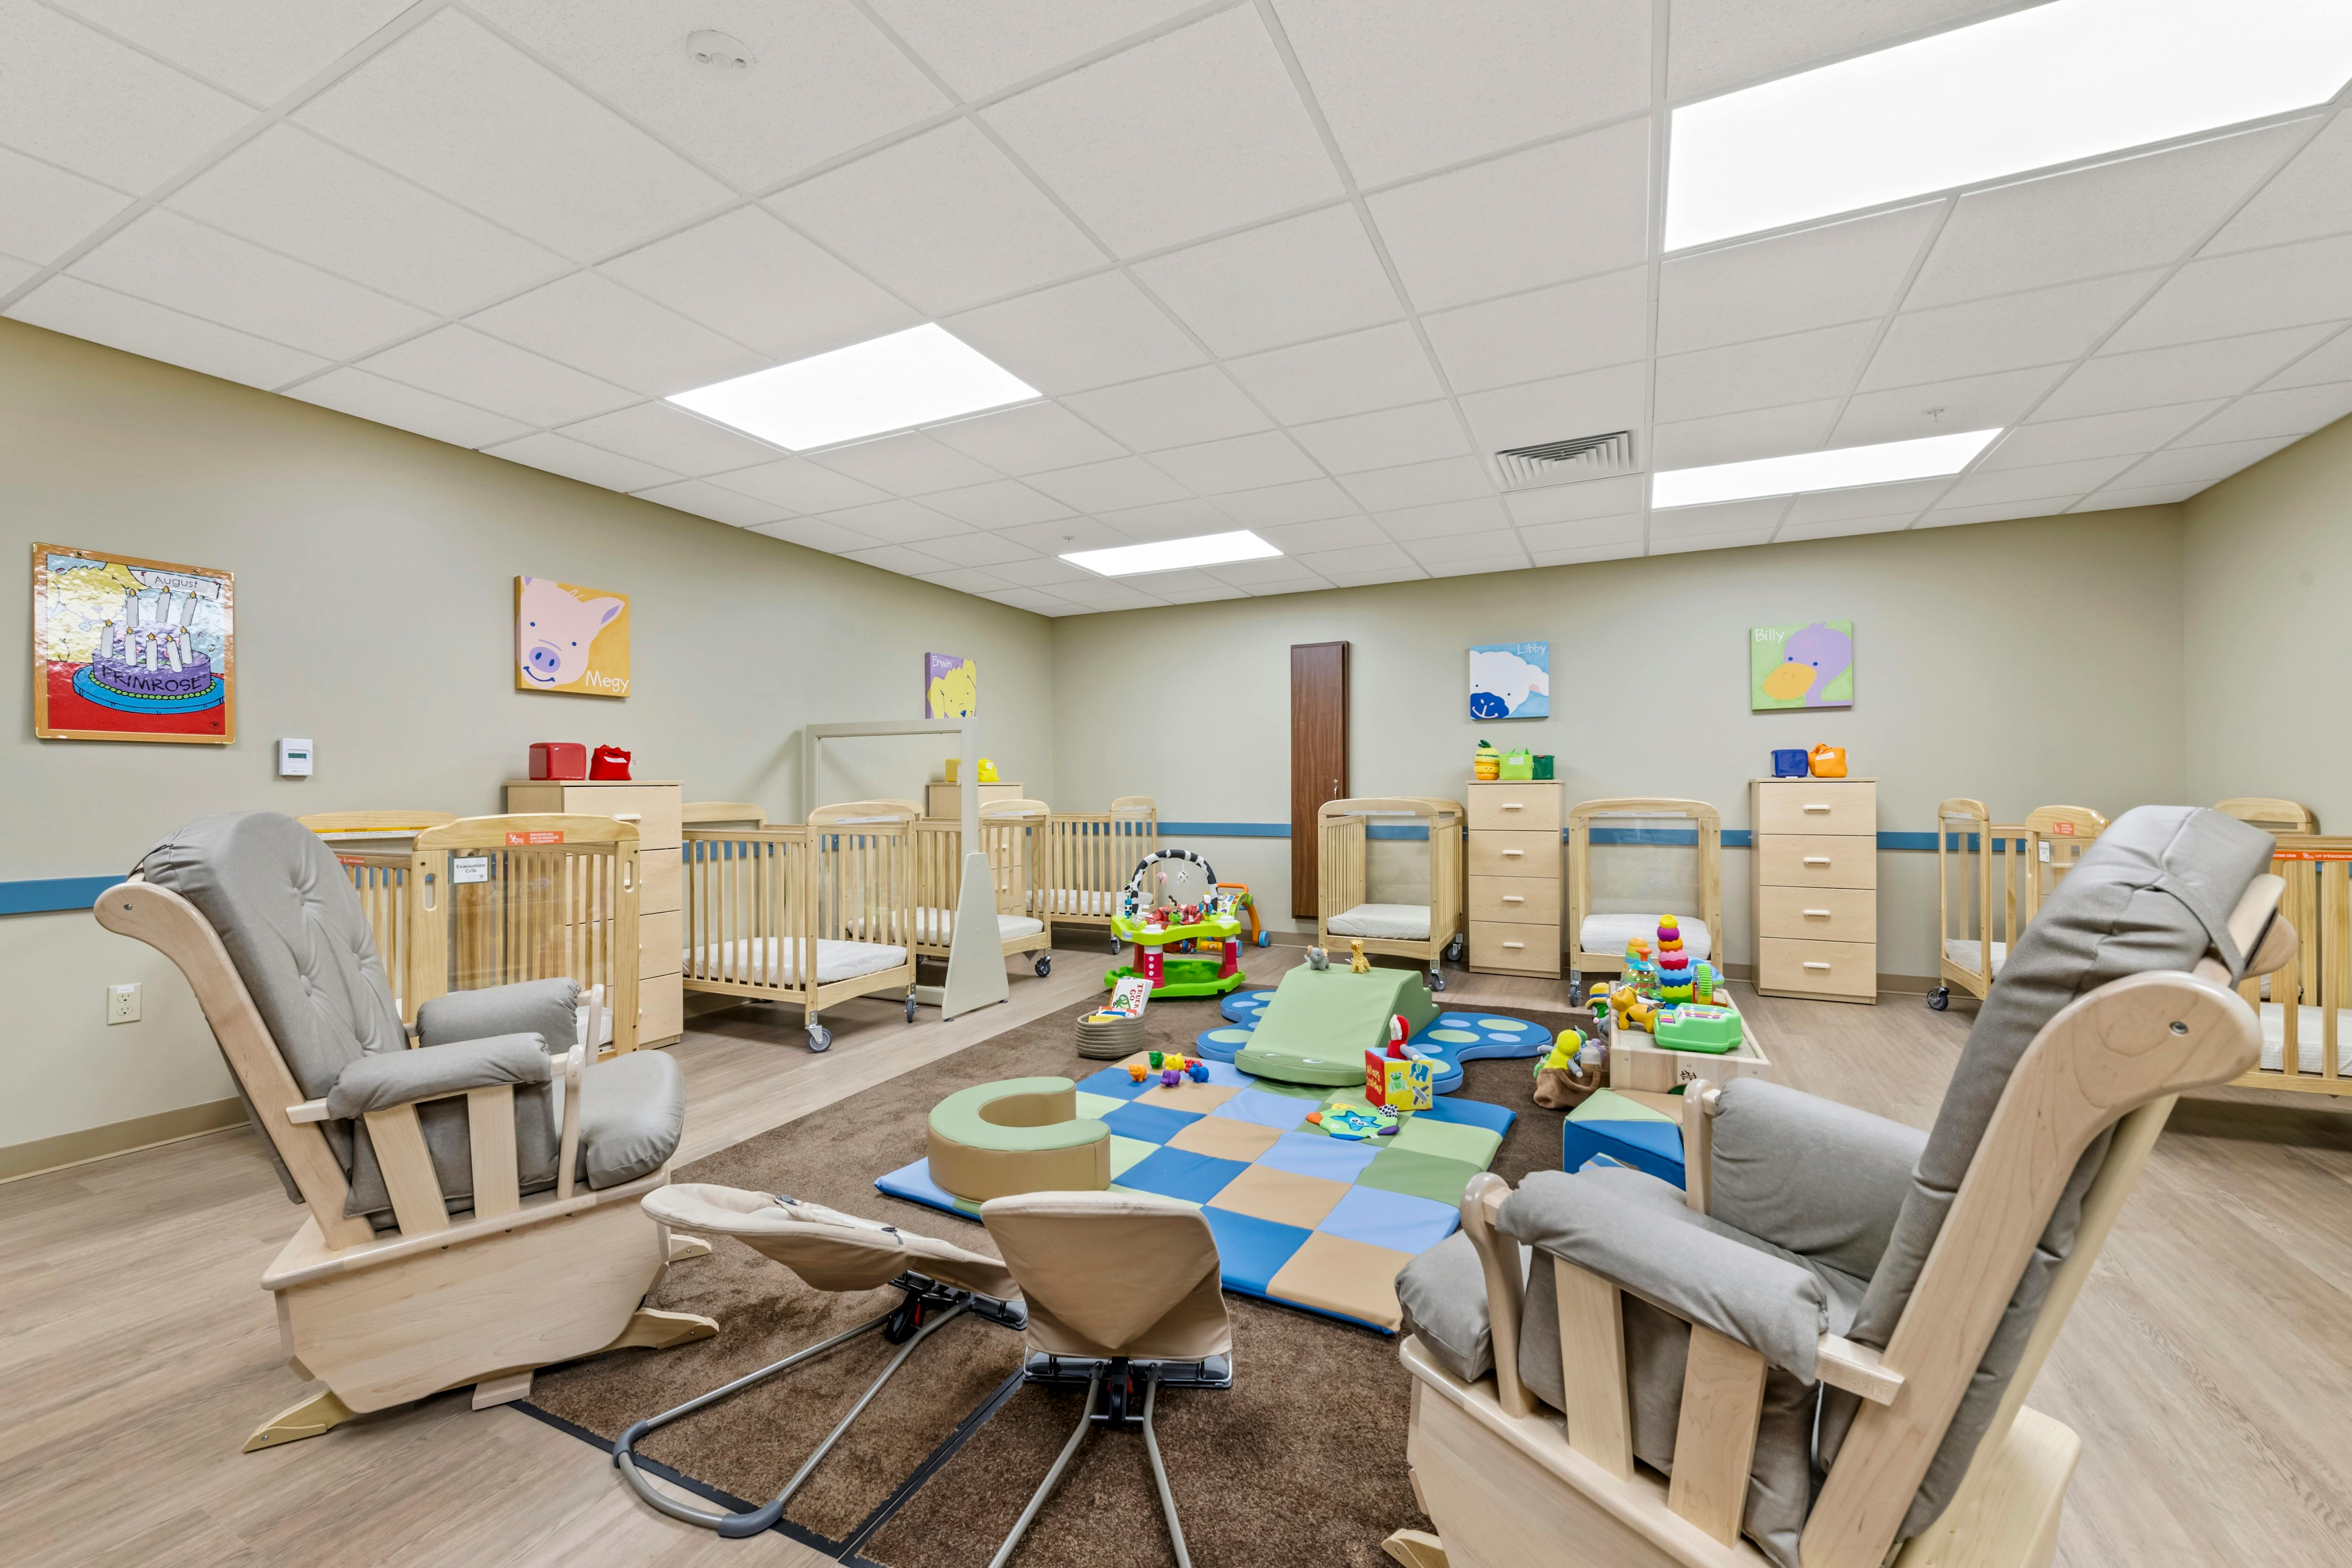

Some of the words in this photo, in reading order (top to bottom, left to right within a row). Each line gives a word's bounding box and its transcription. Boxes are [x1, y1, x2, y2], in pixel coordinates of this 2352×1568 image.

[155, 576, 198, 588] August
[1755, 628, 1785, 644] Billy
[1517, 643, 1547, 655] Libby
[932, 656, 952, 669] Erwin
[585, 670, 629, 693] Megy
[1129, 989, 1136, 1001] GO
